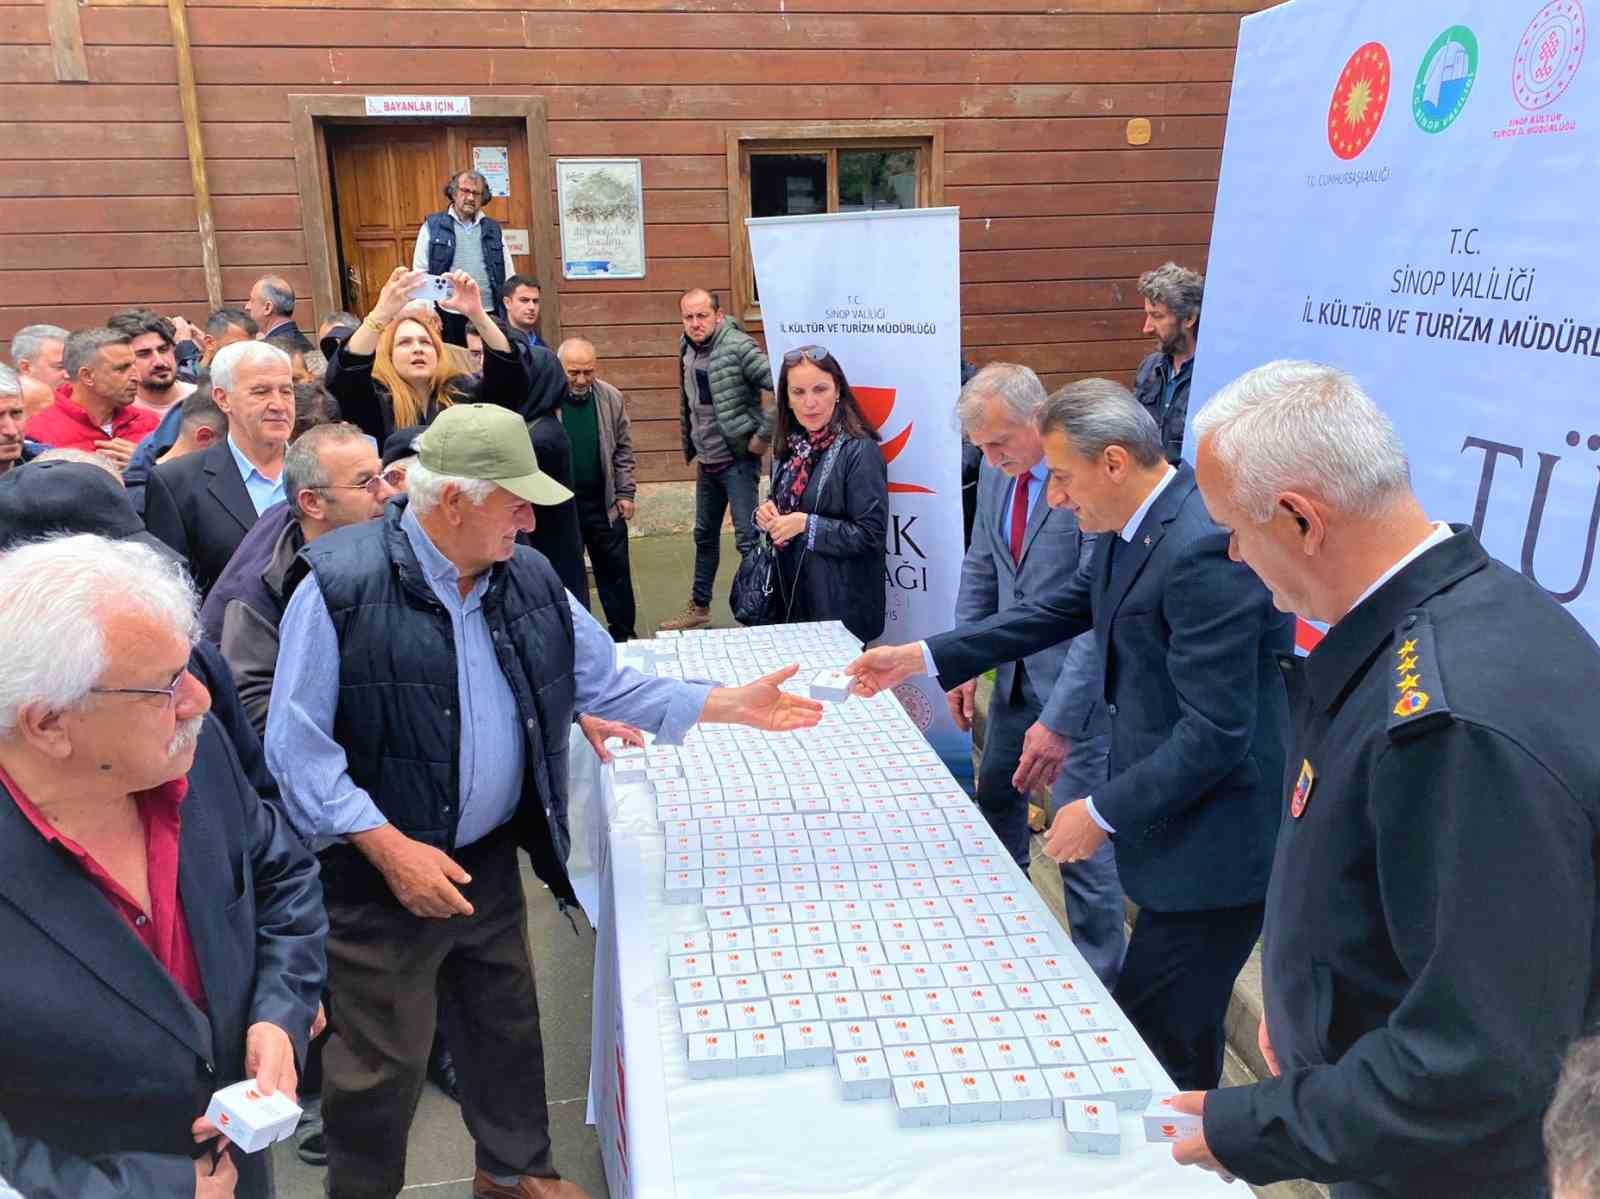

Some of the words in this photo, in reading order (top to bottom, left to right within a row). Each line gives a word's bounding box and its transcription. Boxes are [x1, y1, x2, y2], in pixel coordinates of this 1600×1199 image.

[384, 101, 432, 112] BAYANLAR
[434, 99, 454, 113] İÇİN
[1450, 228, 1480, 255] T.C.
[1391, 263, 1446, 296] SİNOP
[1452, 265, 1536, 303] VALİLİĞİ
[789, 321, 825, 334] KÜLTÜR
[827, 323, 839, 334] VE
[841, 320, 875, 334] TURİZM
[876, 321, 937, 335] MÜDÜRLÜĞÜ
[1302, 296, 1314, 323] İL
[1318, 298, 1382, 332] KÜLTÜR
[1387, 308, 1410, 335] VE
[1415, 307, 1493, 345] TURİZM
[1461, 430, 1600, 604] TÜ
